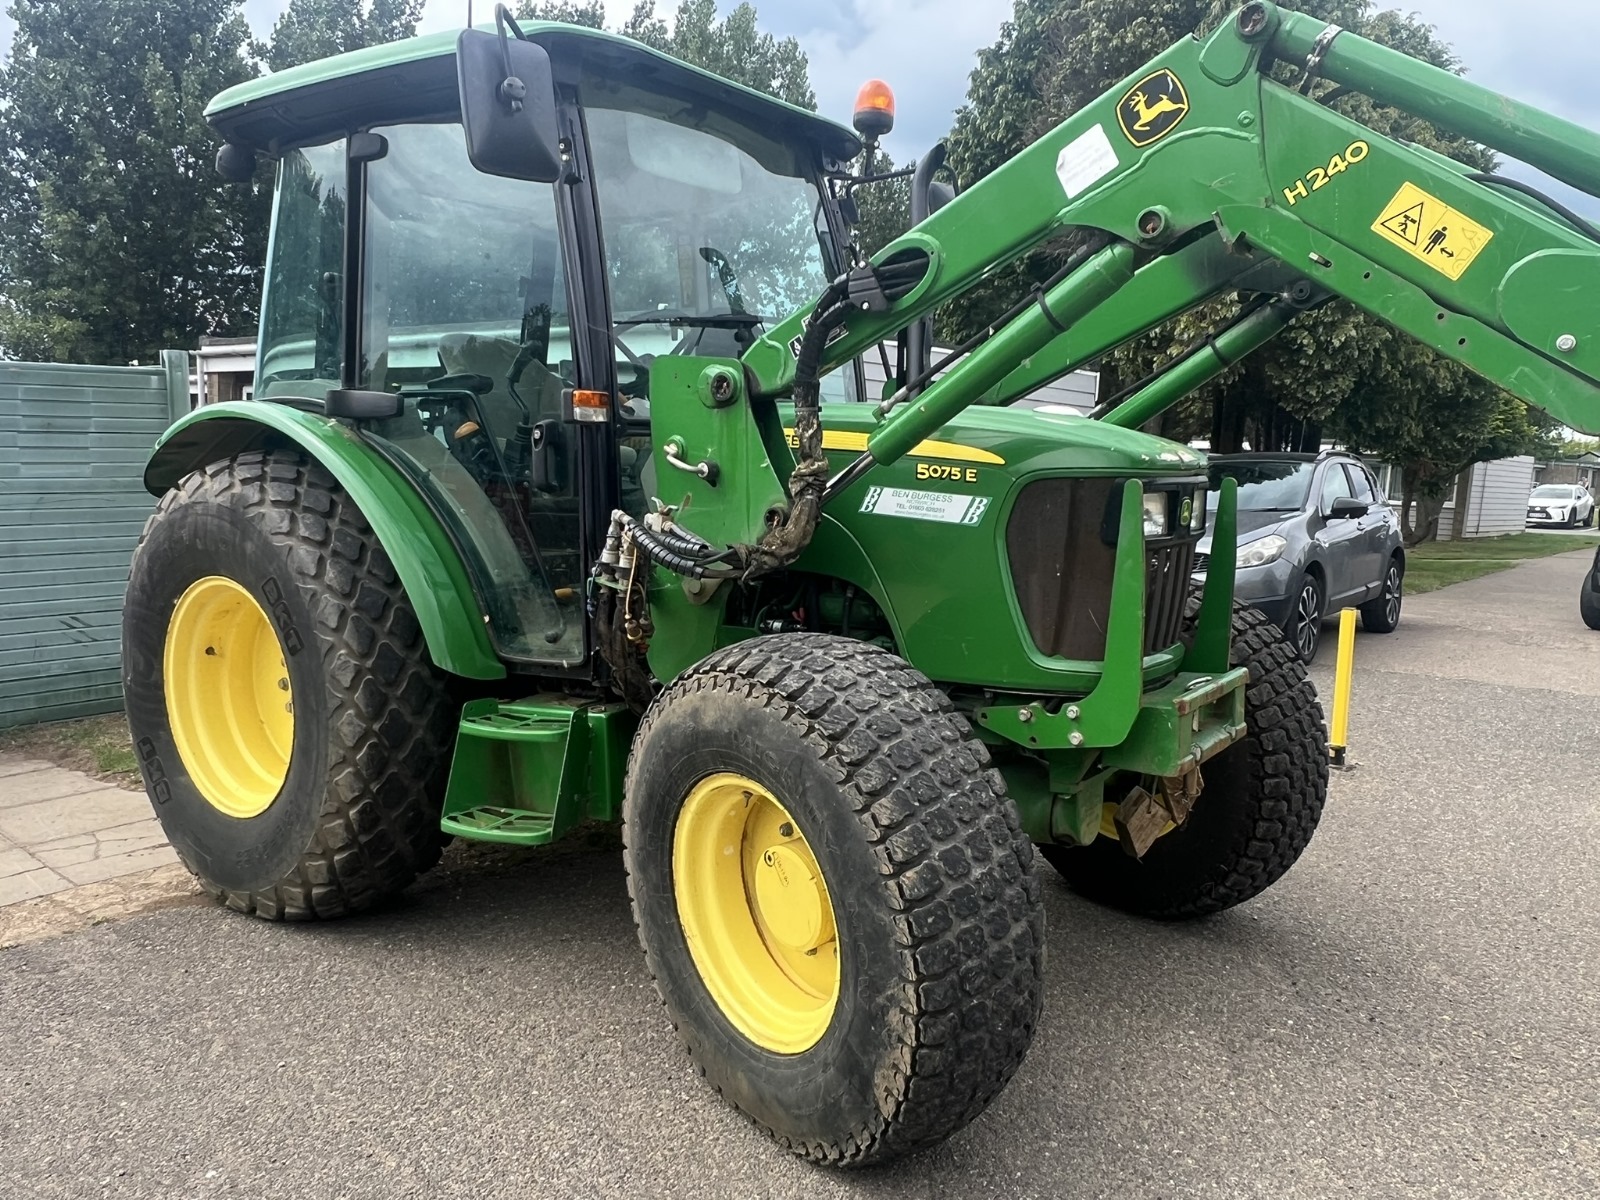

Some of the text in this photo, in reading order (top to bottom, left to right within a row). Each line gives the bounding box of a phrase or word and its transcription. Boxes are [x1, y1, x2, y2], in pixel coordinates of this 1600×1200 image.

[1282, 139, 1370, 207] H 240
[916, 463, 977, 482] 5075 E
[891, 489, 954, 503] BEN BURGESS
